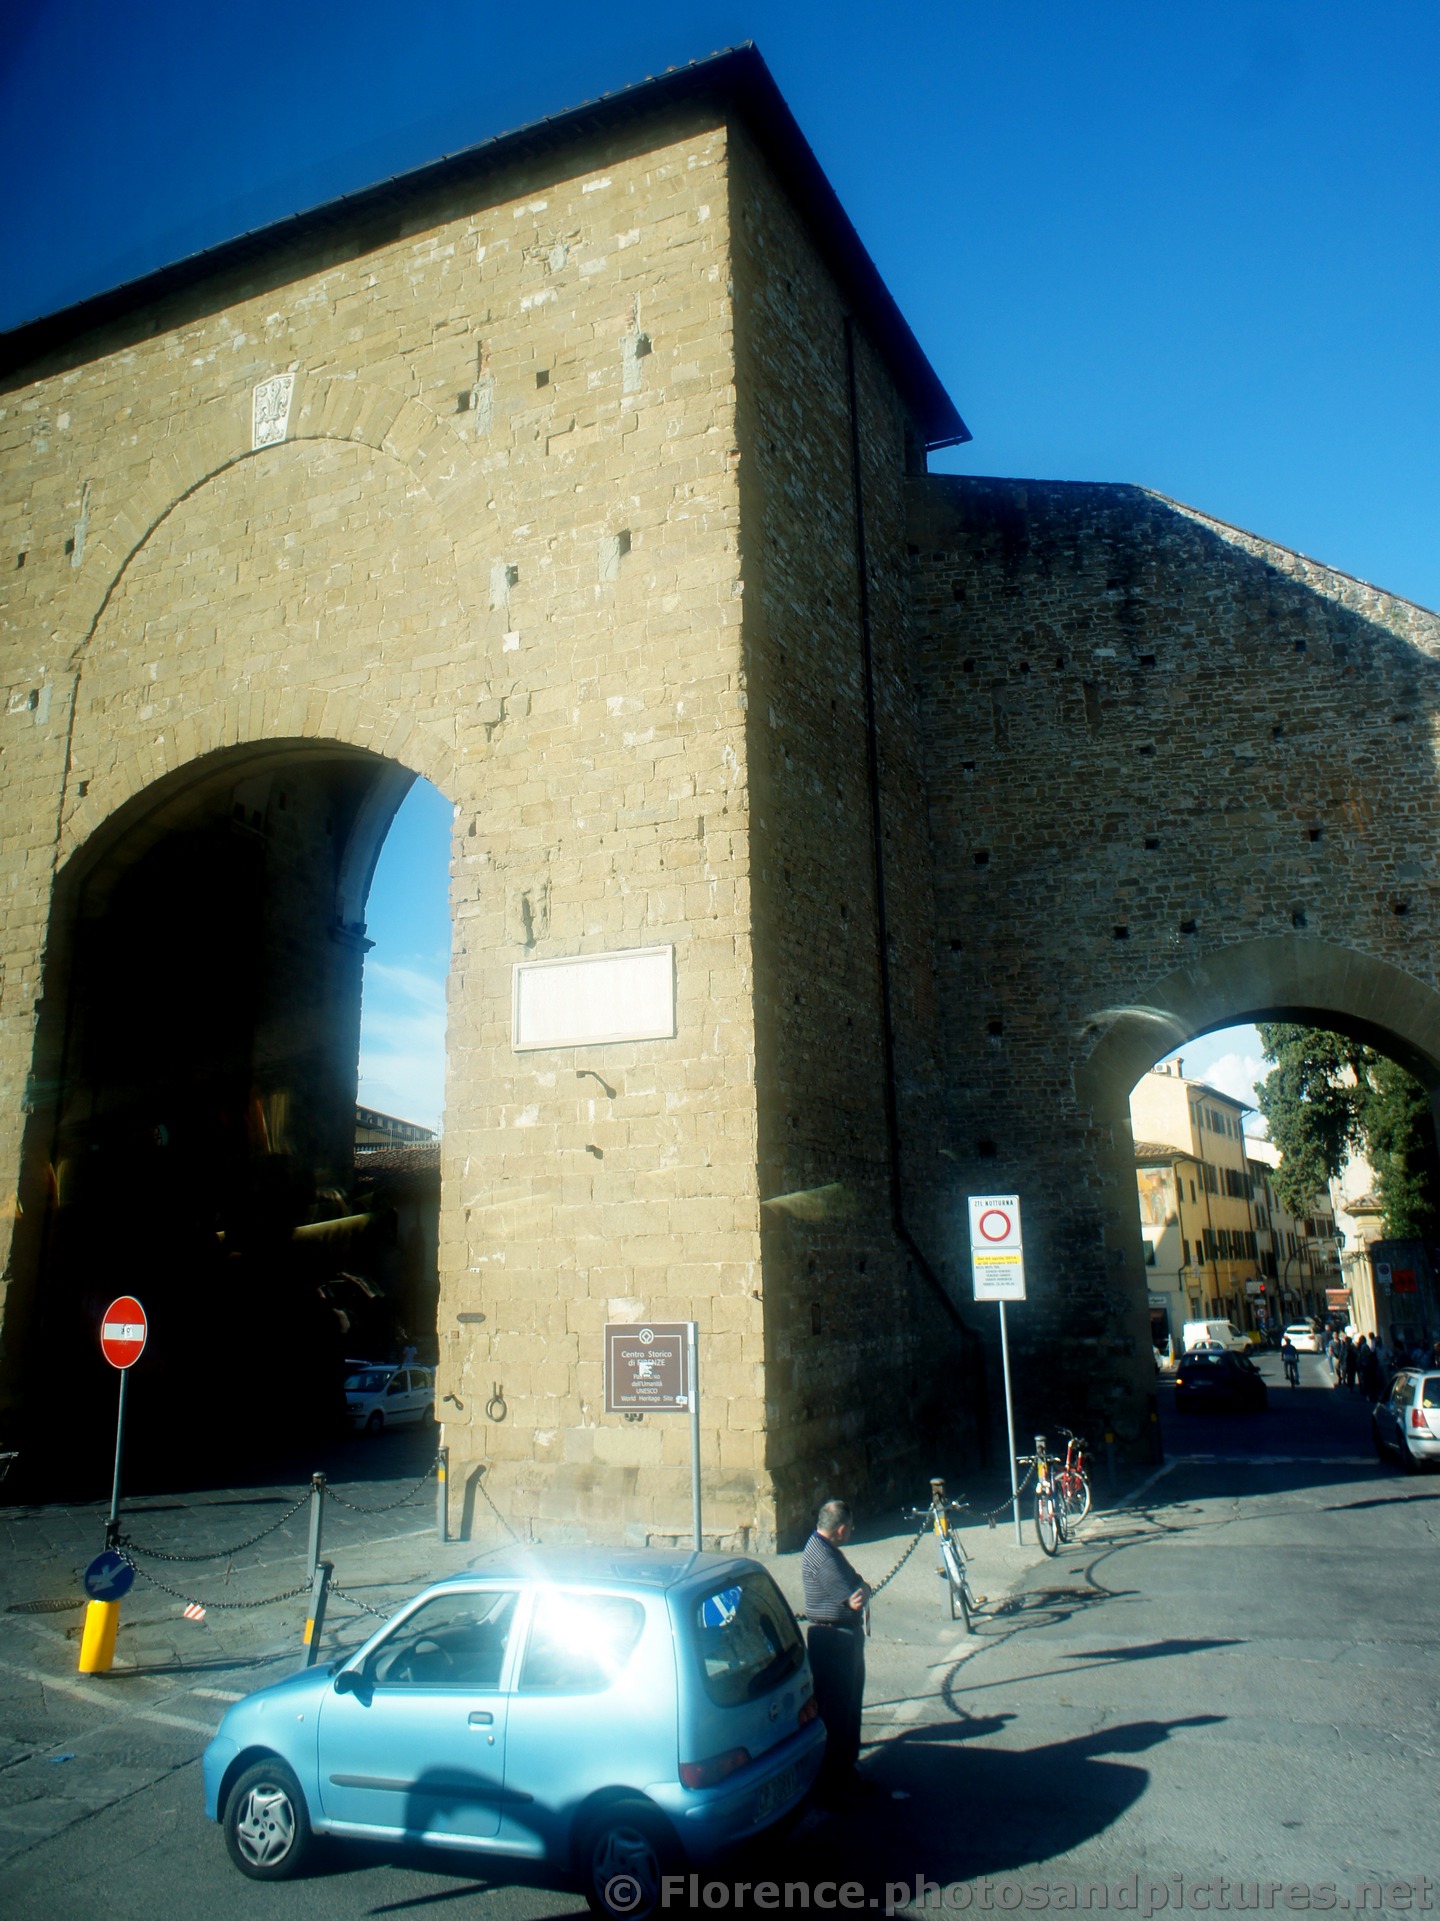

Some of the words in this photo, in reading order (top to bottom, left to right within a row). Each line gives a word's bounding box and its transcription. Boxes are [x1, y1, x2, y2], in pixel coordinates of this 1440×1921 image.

[985, 1199, 1014, 1207] NOTTURNA
[621, 1350, 645, 1358] Centro
[648, 1350, 672, 1358] Storico
[628, 1359, 635, 1367] di
